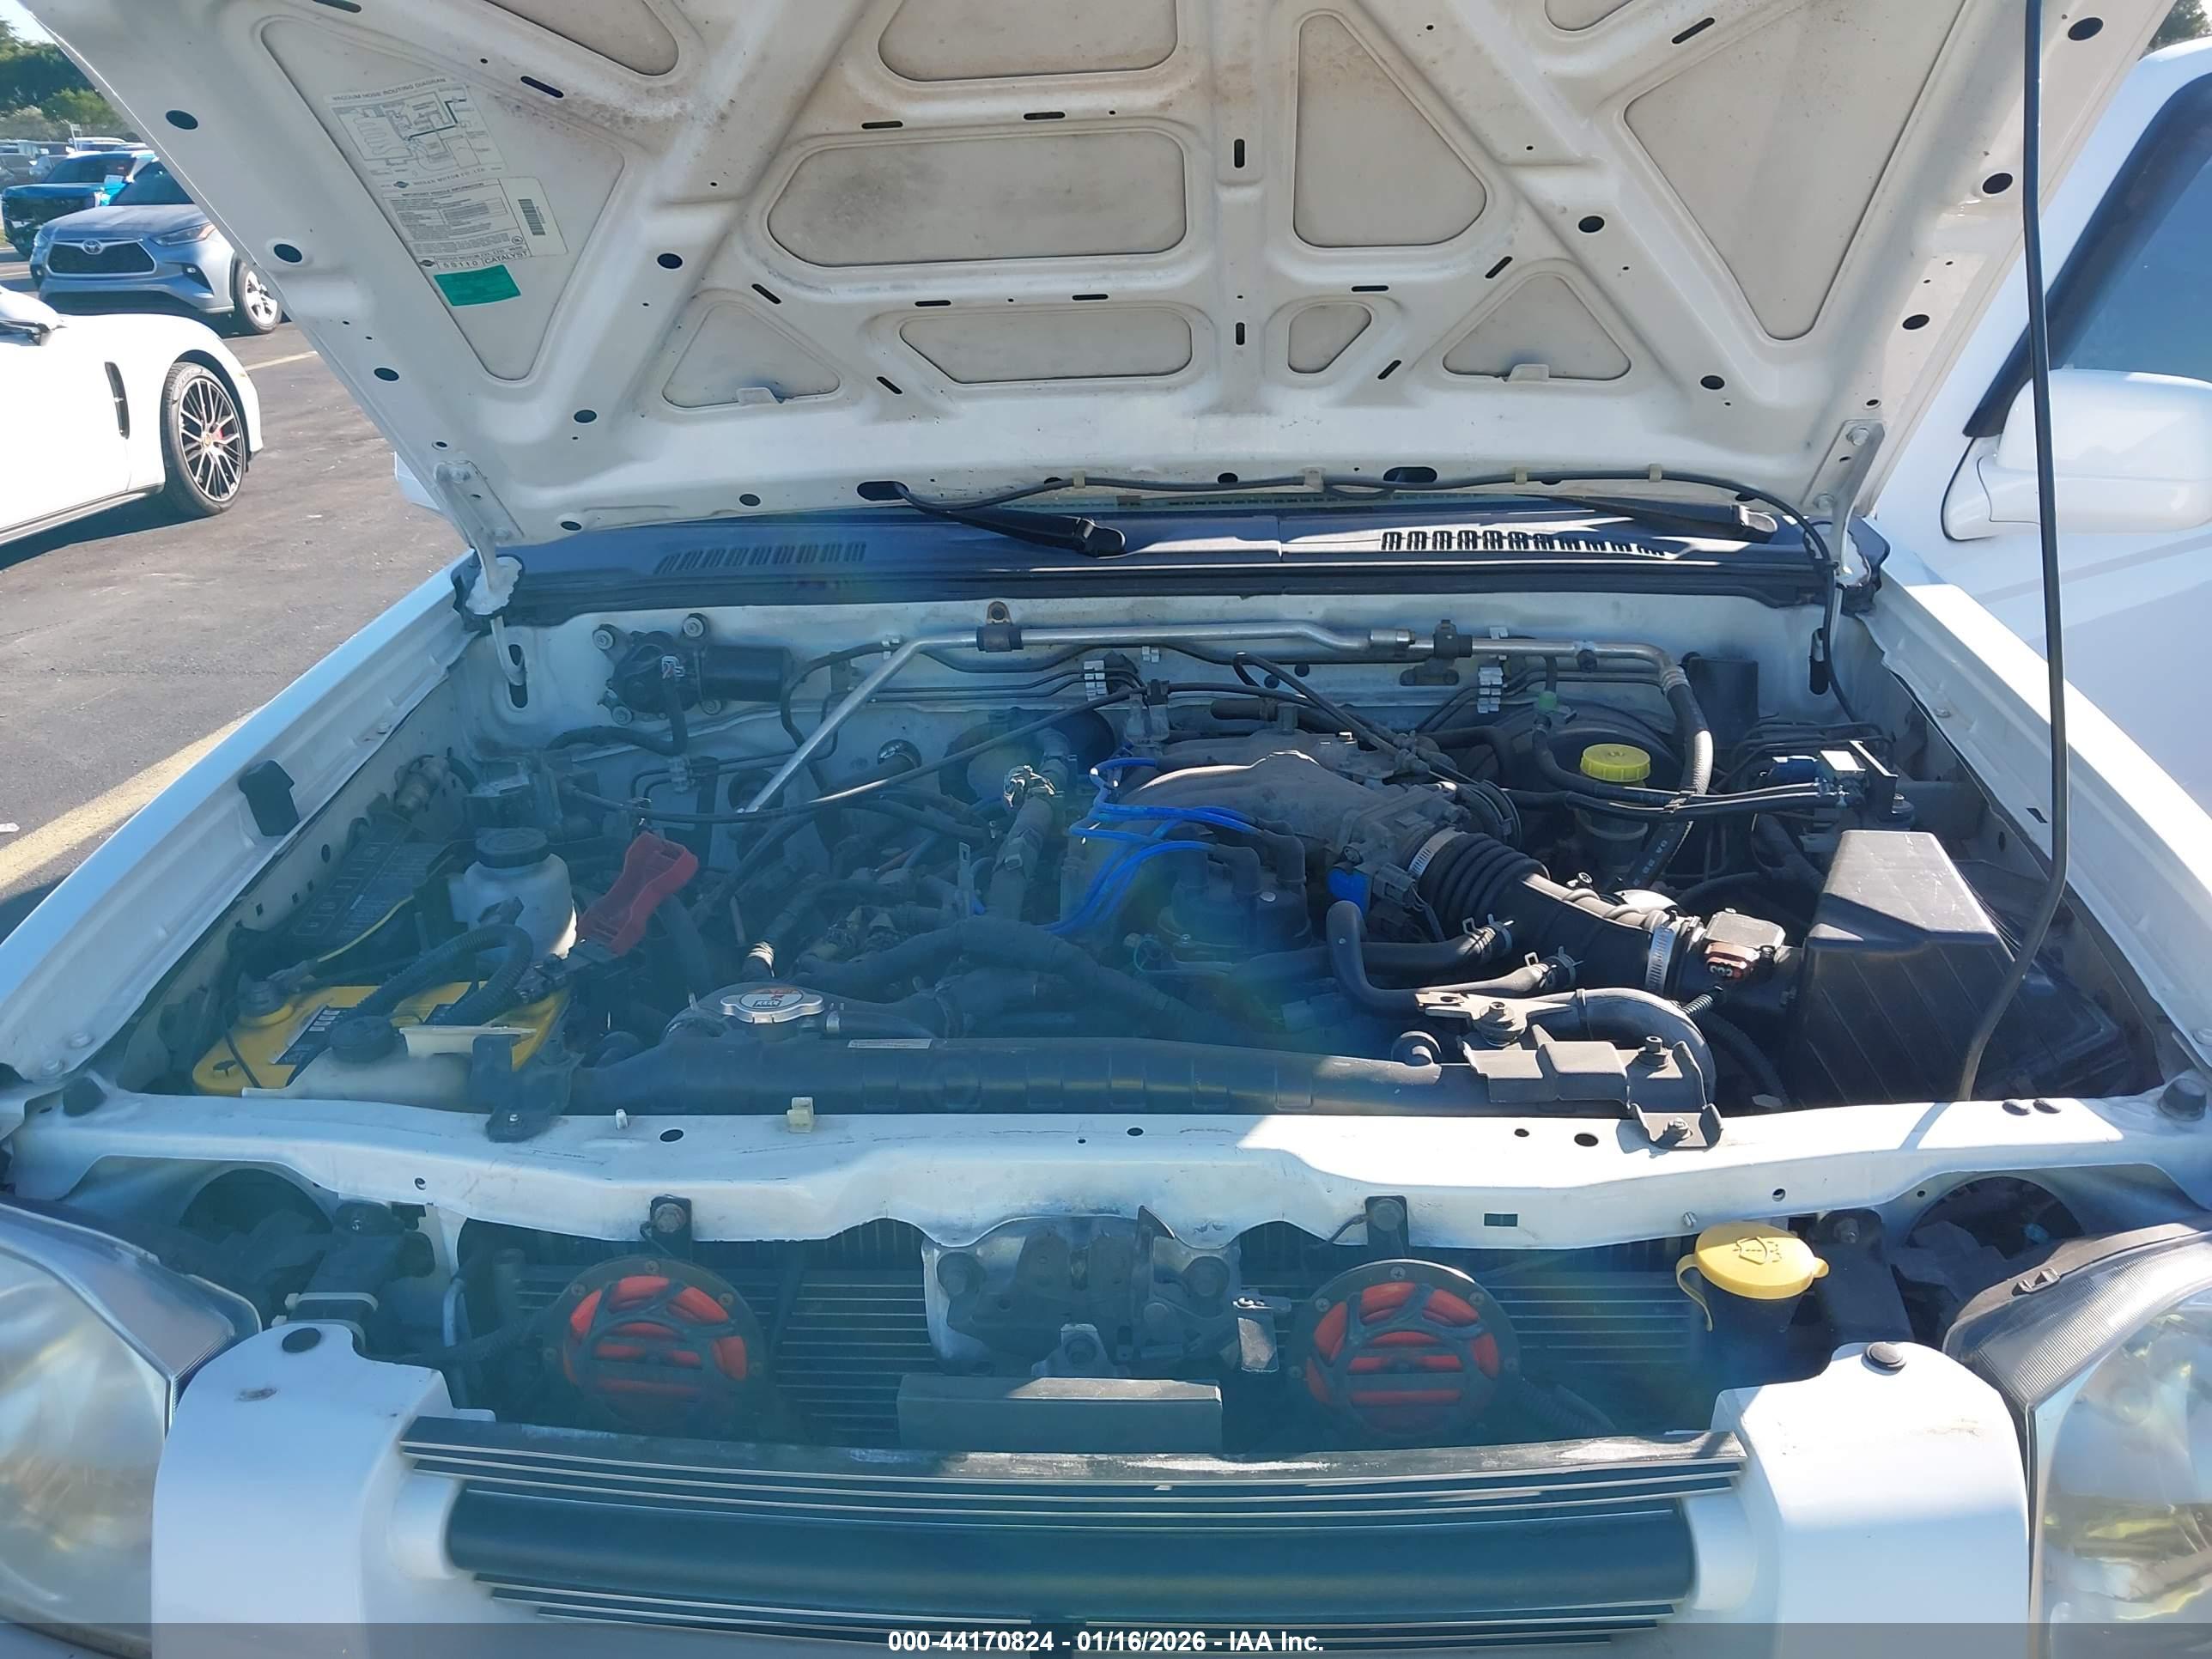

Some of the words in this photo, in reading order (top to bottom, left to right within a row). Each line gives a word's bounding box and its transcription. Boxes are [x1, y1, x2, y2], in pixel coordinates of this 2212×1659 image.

[383, 84, 414, 95] ROUTING
[415, 77, 447, 88] DIAGRAM
[485, 250, 528, 264] CATALYST
